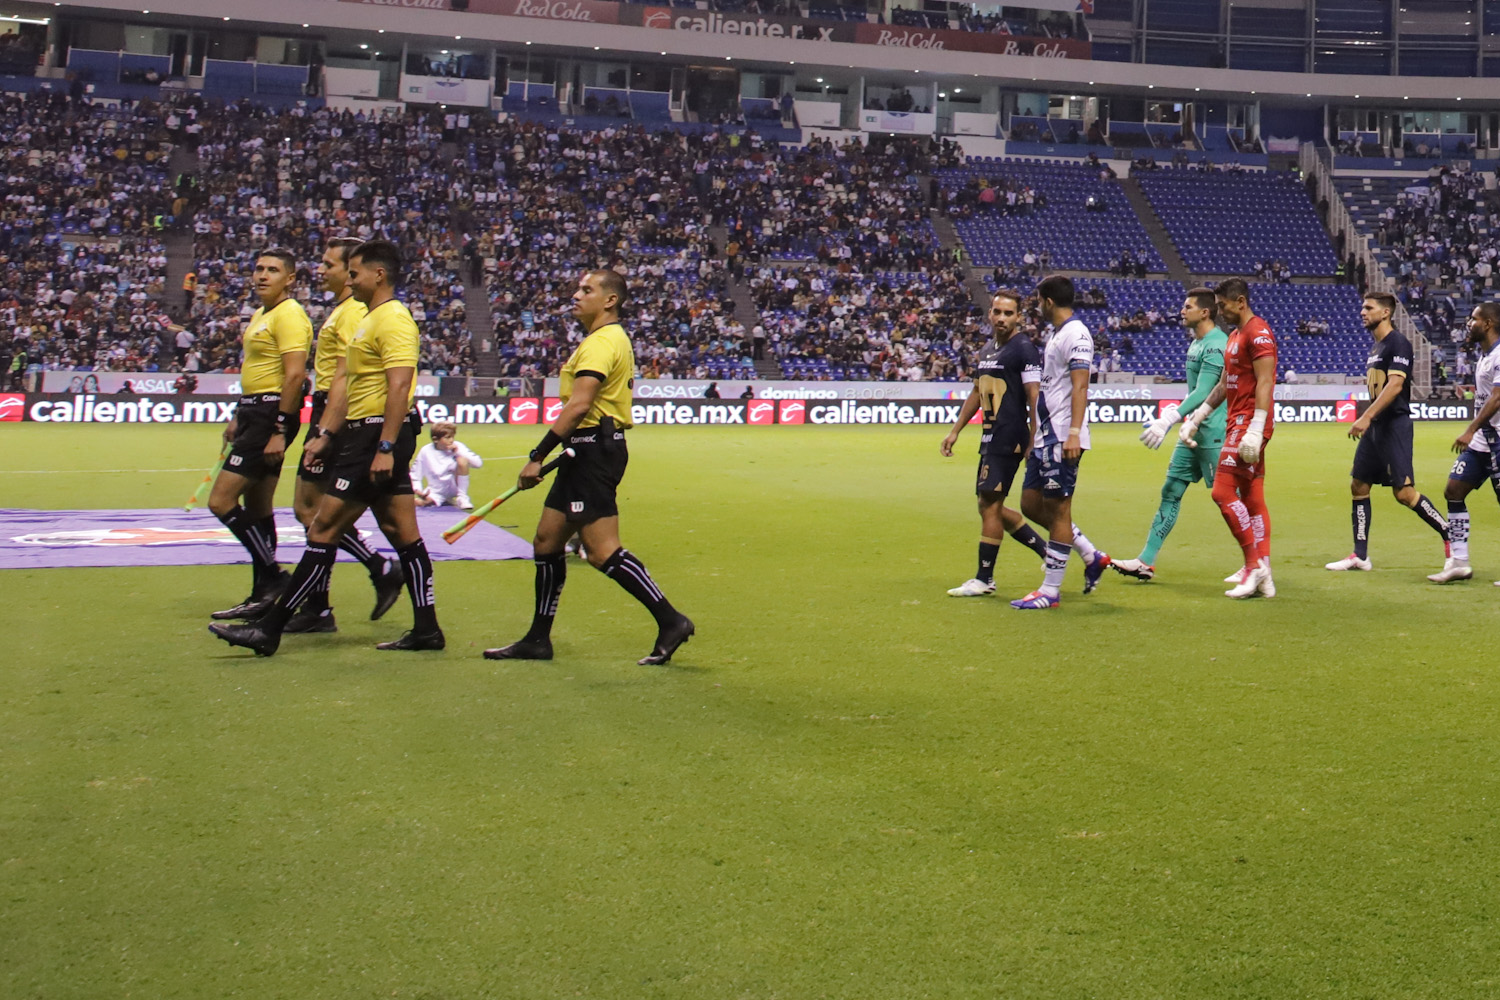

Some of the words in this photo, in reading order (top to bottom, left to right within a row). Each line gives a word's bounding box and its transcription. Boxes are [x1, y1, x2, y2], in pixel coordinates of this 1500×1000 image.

[30, 395, 237, 423] caliente.mx
[810, 400, 960, 424] caliente.mx
[1409, 403, 1468, 419] Steren
[1451, 460, 1466, 475] 26
